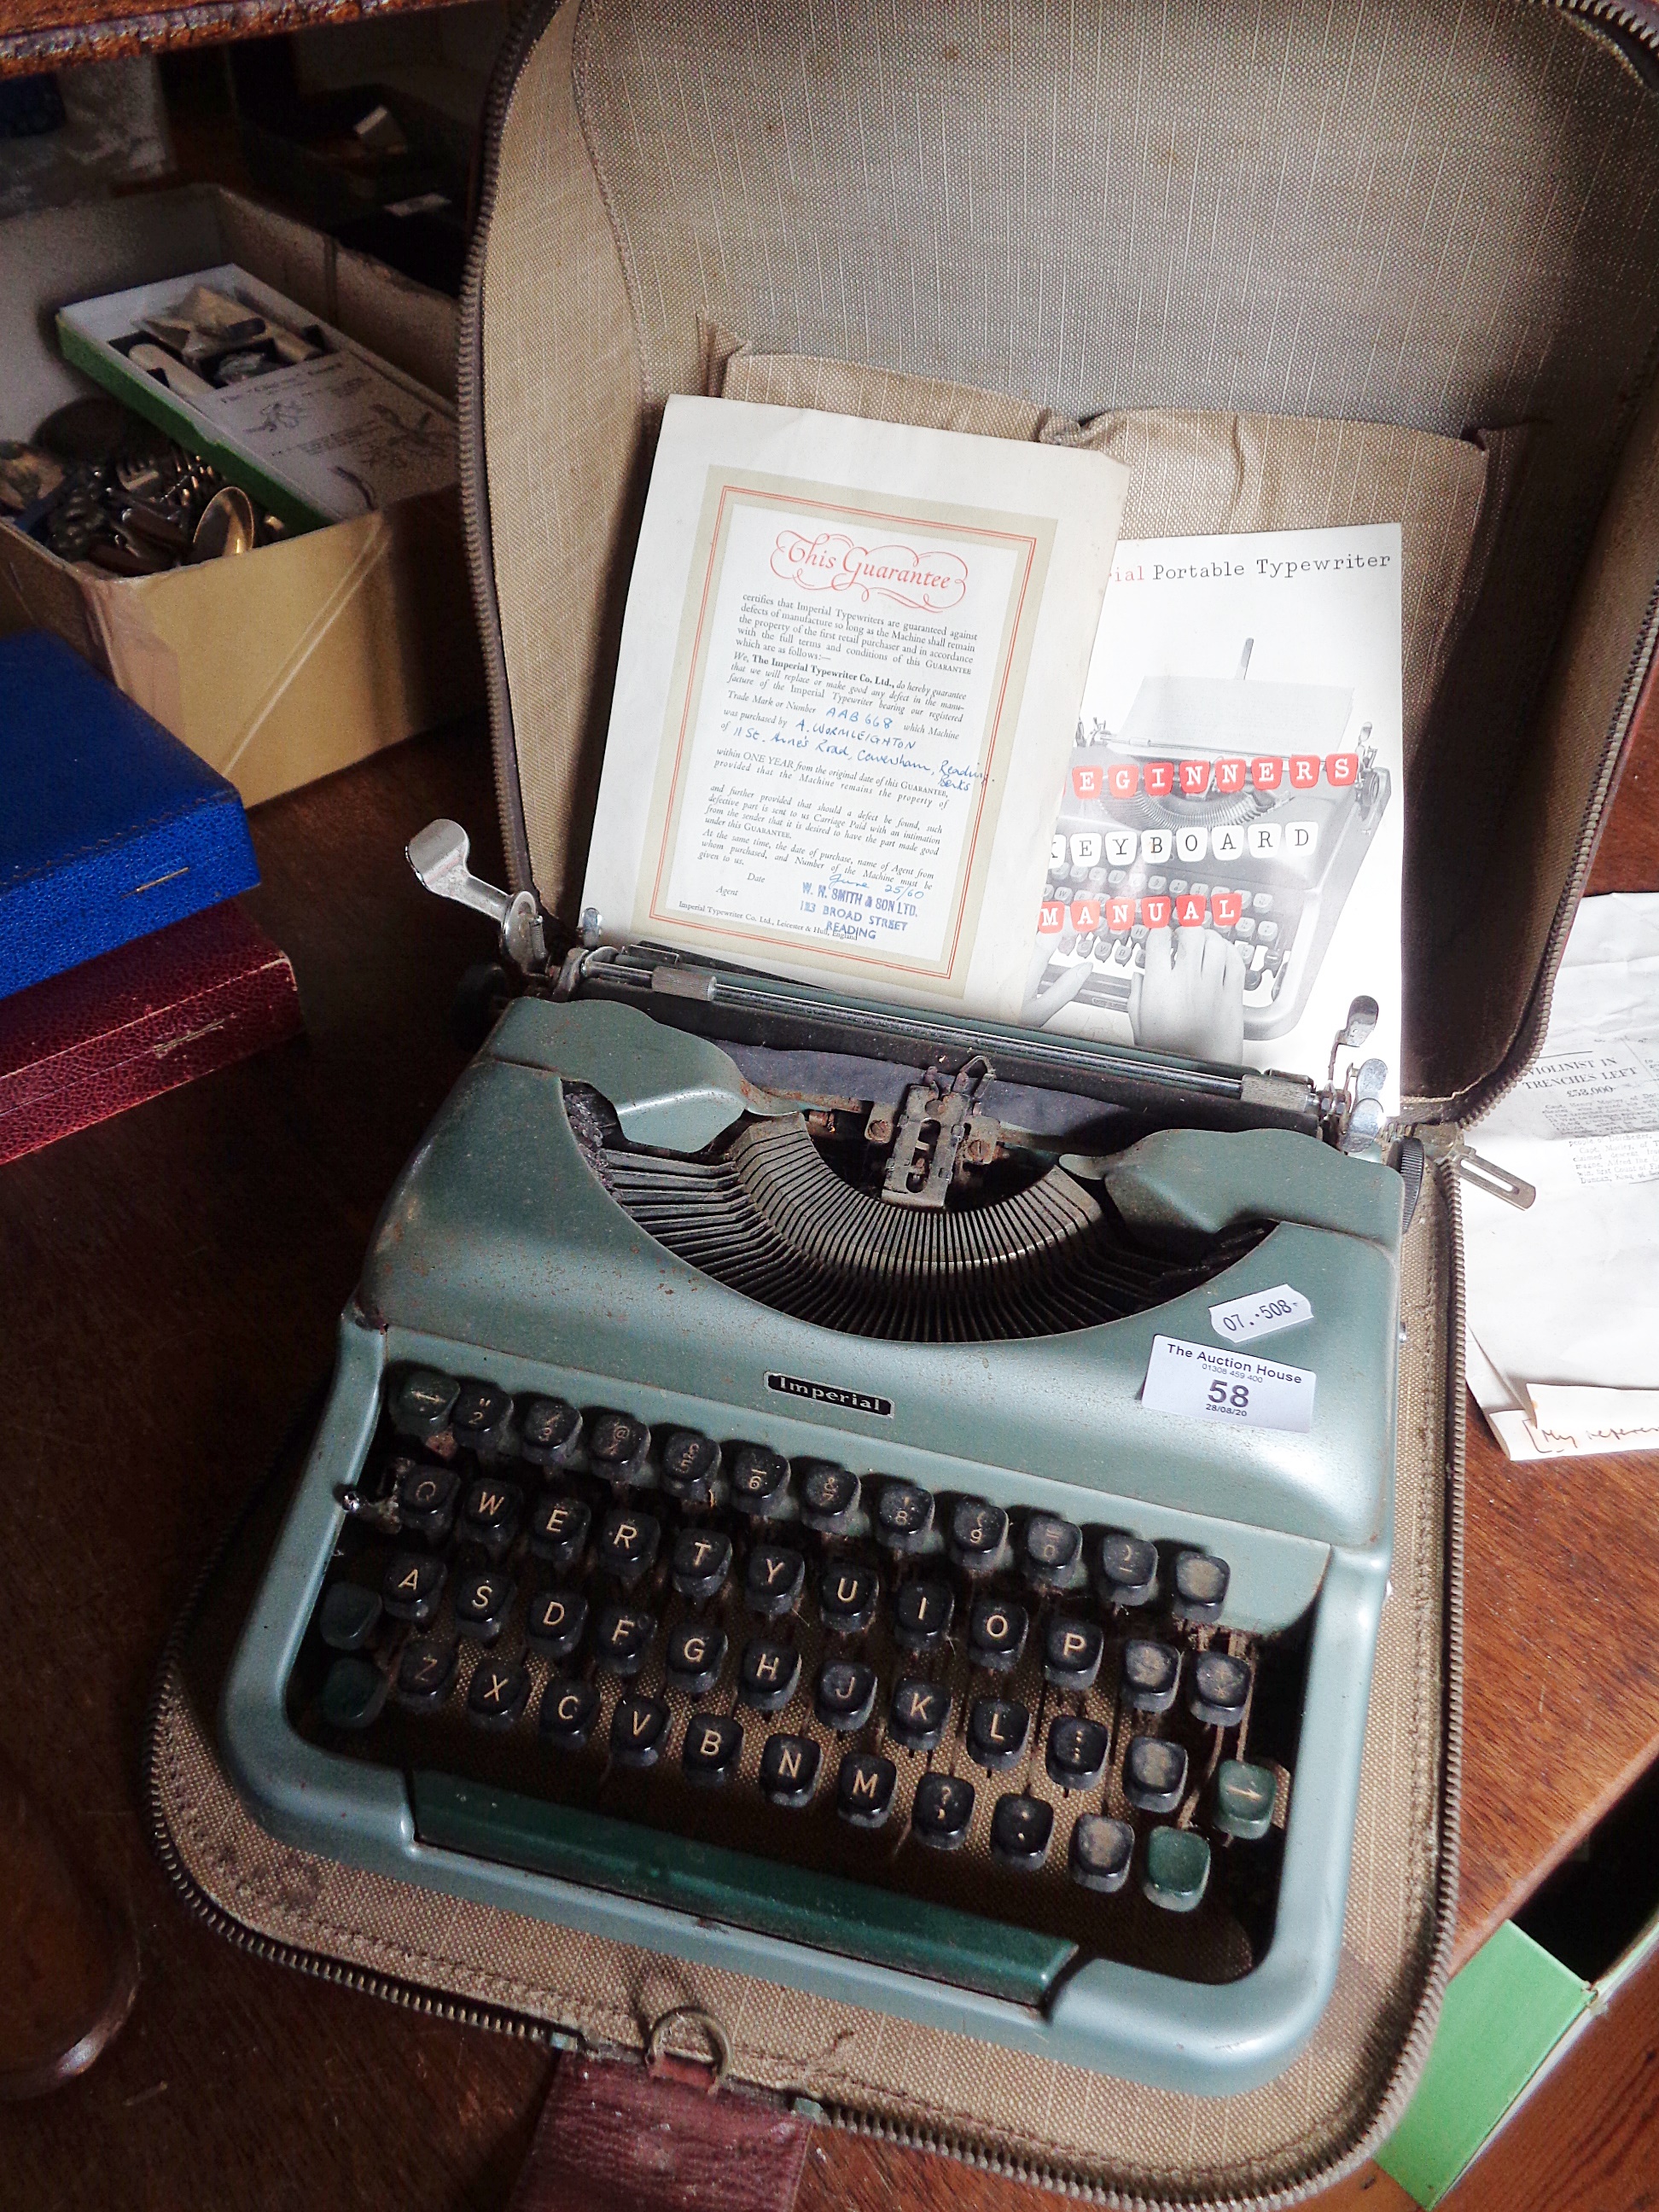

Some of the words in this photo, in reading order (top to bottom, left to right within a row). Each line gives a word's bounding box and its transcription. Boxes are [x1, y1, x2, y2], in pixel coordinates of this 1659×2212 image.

[775, 531, 836, 569] This
[840, 544, 954, 592] Guarantee
[1109, 565, 1144, 582] ial
[1152, 560, 1246, 581] Portable
[1256, 553, 1392, 579] Typewriter
[740, 602, 768, 615] defects
[770, 609, 779, 618] of
[781, 613, 833, 627] manufacture
[845, 619, 864, 635] long
[876, 626, 889, 637] the
[891, 630, 926, 643] Machine
[928, 635, 946, 647] shall
[946, 641, 975, 652] remain
[742, 594, 774, 605] certifies
[777, 597, 794, 608] that
[796, 601, 832, 616] Imperial
[835, 608, 884, 625] Typewriters
[902, 623, 947, 636] guaranteed
[949, 630, 977, 641] against
[735, 637, 760, 649] which
[736, 626, 756, 637] with
[760, 629, 775, 640] the
[778, 633, 794, 643] full
[798, 638, 821, 649] terms
[825, 643, 841, 652] and
[845, 647, 888, 661] conditions
[892, 654, 903, 663] of
[905, 655, 920, 667] this
[924, 659, 971, 675] GUARANTEE
[738, 614, 752, 624] the
[754, 619, 790, 634] property
[792, 625, 801, 633] of
[803, 626, 818, 636] the
[818, 628, 835, 640] first
[837, 633, 860, 644] retail
[860, 638, 900, 651] purchaser
[901, 644, 917, 654] and
[918, 646, 927, 655] in
[928, 650, 974, 663] accordance
[751, 653, 769, 665] The
[771, 657, 808, 672] Imperial
[810, 664, 858, 681] Typewriter
[859, 672, 872, 684] Co.
[874, 675, 894, 689] Ltd.,
[895, 679, 905, 690] do
[906, 681, 931, 696] hereby
[931, 689, 967, 700] guarantee
[726, 672, 754, 685] facture
[759, 679, 768, 690] of
[772, 680, 785, 690] the
[789, 684, 825, 698] Imperial
[832, 692, 873, 707] Typewriter
[878, 699, 905, 715] bearing
[928, 711, 963, 723] registered
[720, 720, 731, 731] of
[728, 690, 749, 701] Trade
[751, 695, 773, 706] Mark
[785, 700, 816, 713] Number
[903, 722, 925, 734] which
[929, 726, 959, 739] Machine
[738, 712, 777, 724] purchased
[777, 716, 788, 729] by
[825, 707, 859, 722] AAB
[864, 713, 893, 730] 668
[1079, 757, 1351, 791] EGINNERS
[715, 885, 738, 897] Agent
[746, 871, 765, 883] Date
[830, 887, 863, 905] SMITH
[875, 897, 895, 912] SON
[896, 901, 917, 917] LTD.
[885, 884, 924, 901] 25/60
[678, 900, 706, 911] Imperial
[707, 905, 743, 918] Typewriter
[744, 913, 757, 922] Co.
[759, 916, 774, 926] Ltd.,
[776, 918, 804, 930] Leicester
[822, 905, 863, 922] BROAD
[868, 915, 908, 931] STREET
[1040, 895, 1236, 928] MANUAL
[825, 921, 877, 940] READING
[1601, 1057, 1618, 1067] IN
[1522, 1073, 1597, 1090] TRENCHES
[1603, 1067, 1639, 1081] LEFT
[1167, 1343, 1193, 1358] The
[1196, 1351, 1251, 1372] Auction
[1256, 1365, 1302, 1384] House
[780, 1377, 880, 1412] Imperial
[1208, 1379, 1249, 1408] 58
[1206, 1403, 1248, 1417] 28/08/20
[478, 1492, 504, 1516] W
[546, 1509, 568, 1533] E
[613, 1524, 637, 1549] R
[694, 1541, 711, 1568] T
[766, 1558, 784, 1585] Y
[838, 1577, 858, 1603] U
[918, 1597, 927, 1621] I
[987, 1615, 1008, 1638] O
[1063, 1632, 1087, 1656] P
[398, 1569, 419, 1592] A
[472, 1585, 493, 1609] S
[543, 1601, 565, 1627] D
[612, 1619, 635, 1642] F
[683, 1638, 705, 1662] G
[756, 1653, 780, 1681] H
[835, 1675, 856, 1699] J
[910, 1692, 933, 1720] K
[990, 1713, 1004, 1741] L
[485, 1674, 509, 1700] X
[557, 1696, 579, 1720] C
[632, 1710, 651, 1737] V
[700, 1729, 721, 1755] B
[778, 1752, 801, 1779] N
[853, 1770, 878, 1797] M
